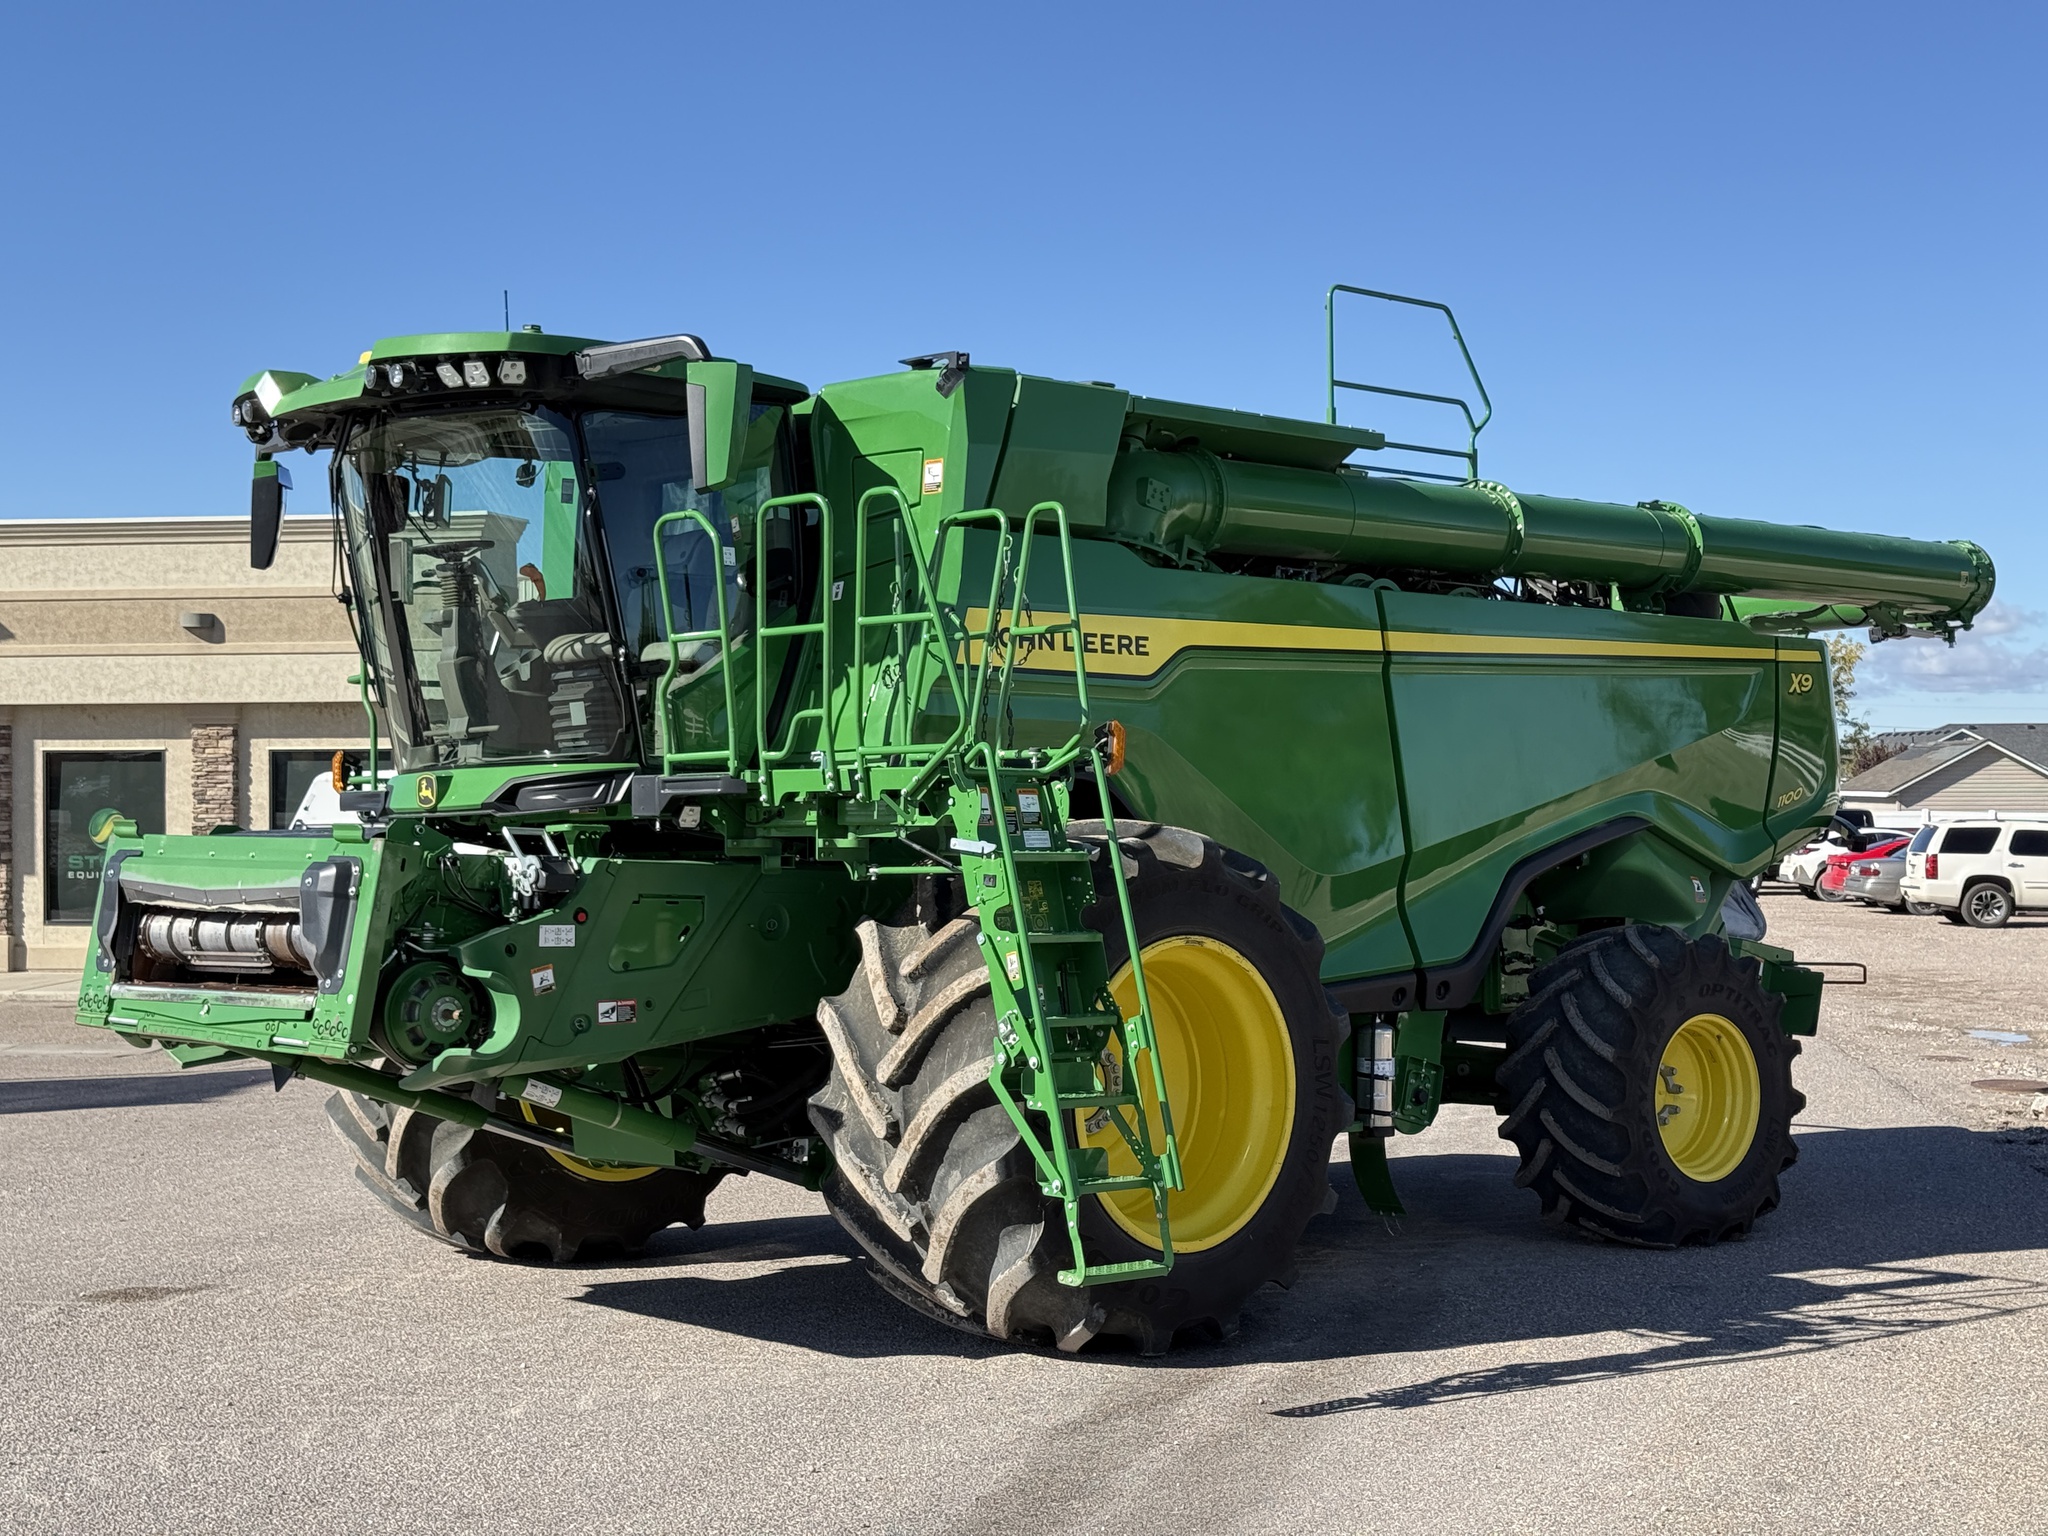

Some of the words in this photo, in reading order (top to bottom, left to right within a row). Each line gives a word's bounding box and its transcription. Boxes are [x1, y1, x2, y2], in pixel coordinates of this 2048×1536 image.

[994, 627, 1055, 651] OHN
[1788, 672, 1813, 695] X9
[1777, 787, 1803, 809] 1100
[68, 854, 105, 870] ST
[68, 871, 101, 880] EQUI
